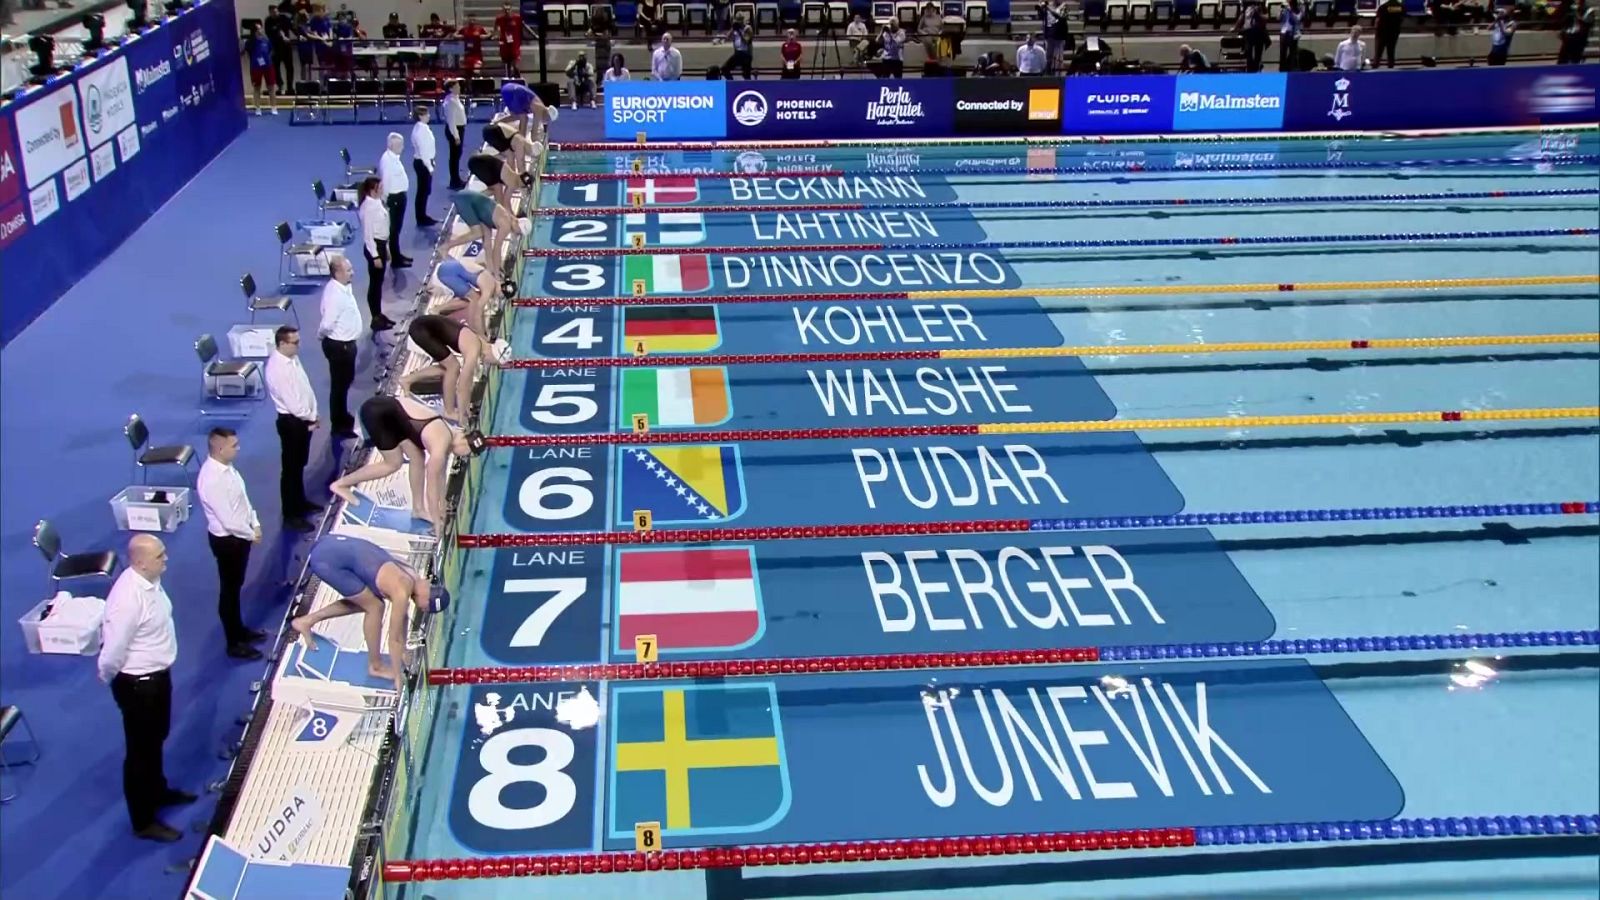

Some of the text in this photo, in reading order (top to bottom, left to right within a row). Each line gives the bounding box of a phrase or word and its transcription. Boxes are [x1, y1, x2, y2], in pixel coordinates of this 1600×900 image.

[879, 86, 911, 104] Perla
[1087, 94, 1150, 103] FLUIDRA
[1200, 94, 1280, 109] Malmsten
[776, 100, 833, 109] PHOENICIA
[956, 100, 1023, 111] Connected by
[613, 110, 667, 123] SPORT
[776, 111, 817, 120] HOTELS
[637, 342, 644, 353] 4
[637, 418, 644, 430] 5
[639, 515, 647, 528] 6
[642, 642, 651, 659] 7
[313, 718, 327, 737] 8
[250, 796, 305, 859] UIDRA
[643, 829, 654, 847] 8
